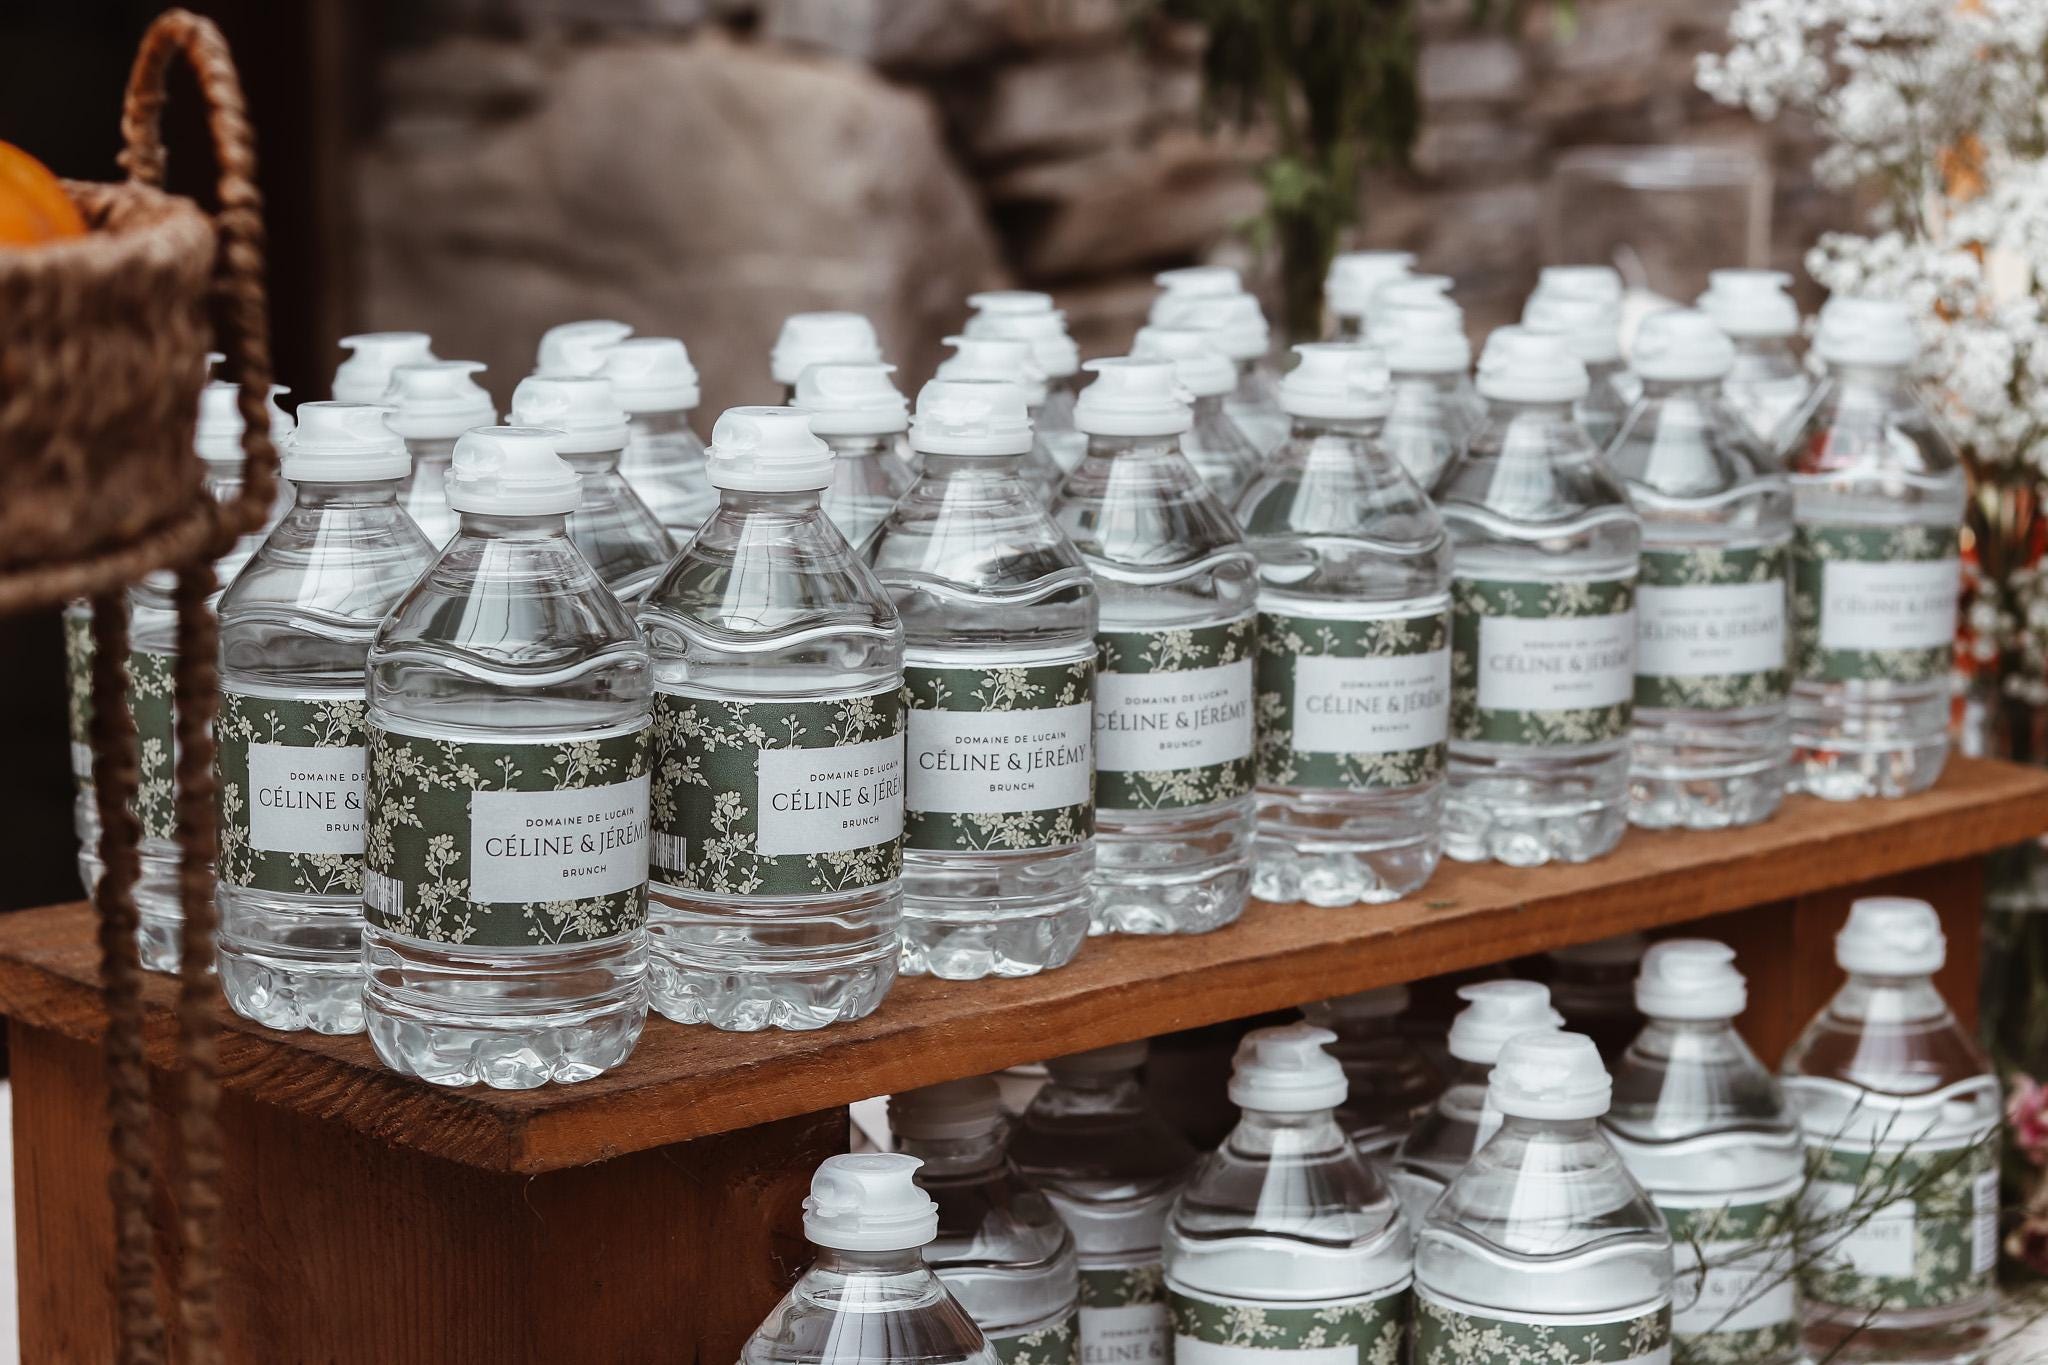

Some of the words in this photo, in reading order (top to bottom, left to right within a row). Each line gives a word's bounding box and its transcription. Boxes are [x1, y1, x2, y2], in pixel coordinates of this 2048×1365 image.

[1125, 696, 1176, 705] DOMAINE
[1182, 694, 1194, 703] DE
[1175, 711, 1189, 729] &
[955, 736, 1009, 744] DOMAINE
[1014, 735, 1028, 743] DE
[1032, 731, 1066, 742] LUCAIN
[1159, 740, 1202, 750] BRUNCH
[919, 749, 1000, 771] CÉLINE
[1007, 752, 1022, 770] &
[1027, 743, 1086, 773] JÉRÉMY
[290, 772, 345, 781] DOMAINE
[810, 769, 859, 782] DOMAINE
[863, 766, 874, 776] DE
[989, 782, 1035, 792] BRUNCH
[259, 785, 337, 809] CÉLINE
[344, 791, 362, 809] &
[772, 789, 852, 811] CÉLINE
[857, 786, 870, 804] &
[526, 816, 582, 828] DOMAINE
[587, 814, 601, 823] DE
[604, 806, 635, 821] LUCAIN
[842, 815, 880, 829] BRUNCH
[485, 834, 573, 857] CÉLINE
[580, 833, 595, 853] &
[599, 817, 648, 856] JÉRÉMY
[562, 864, 607, 878] BRUNCH
